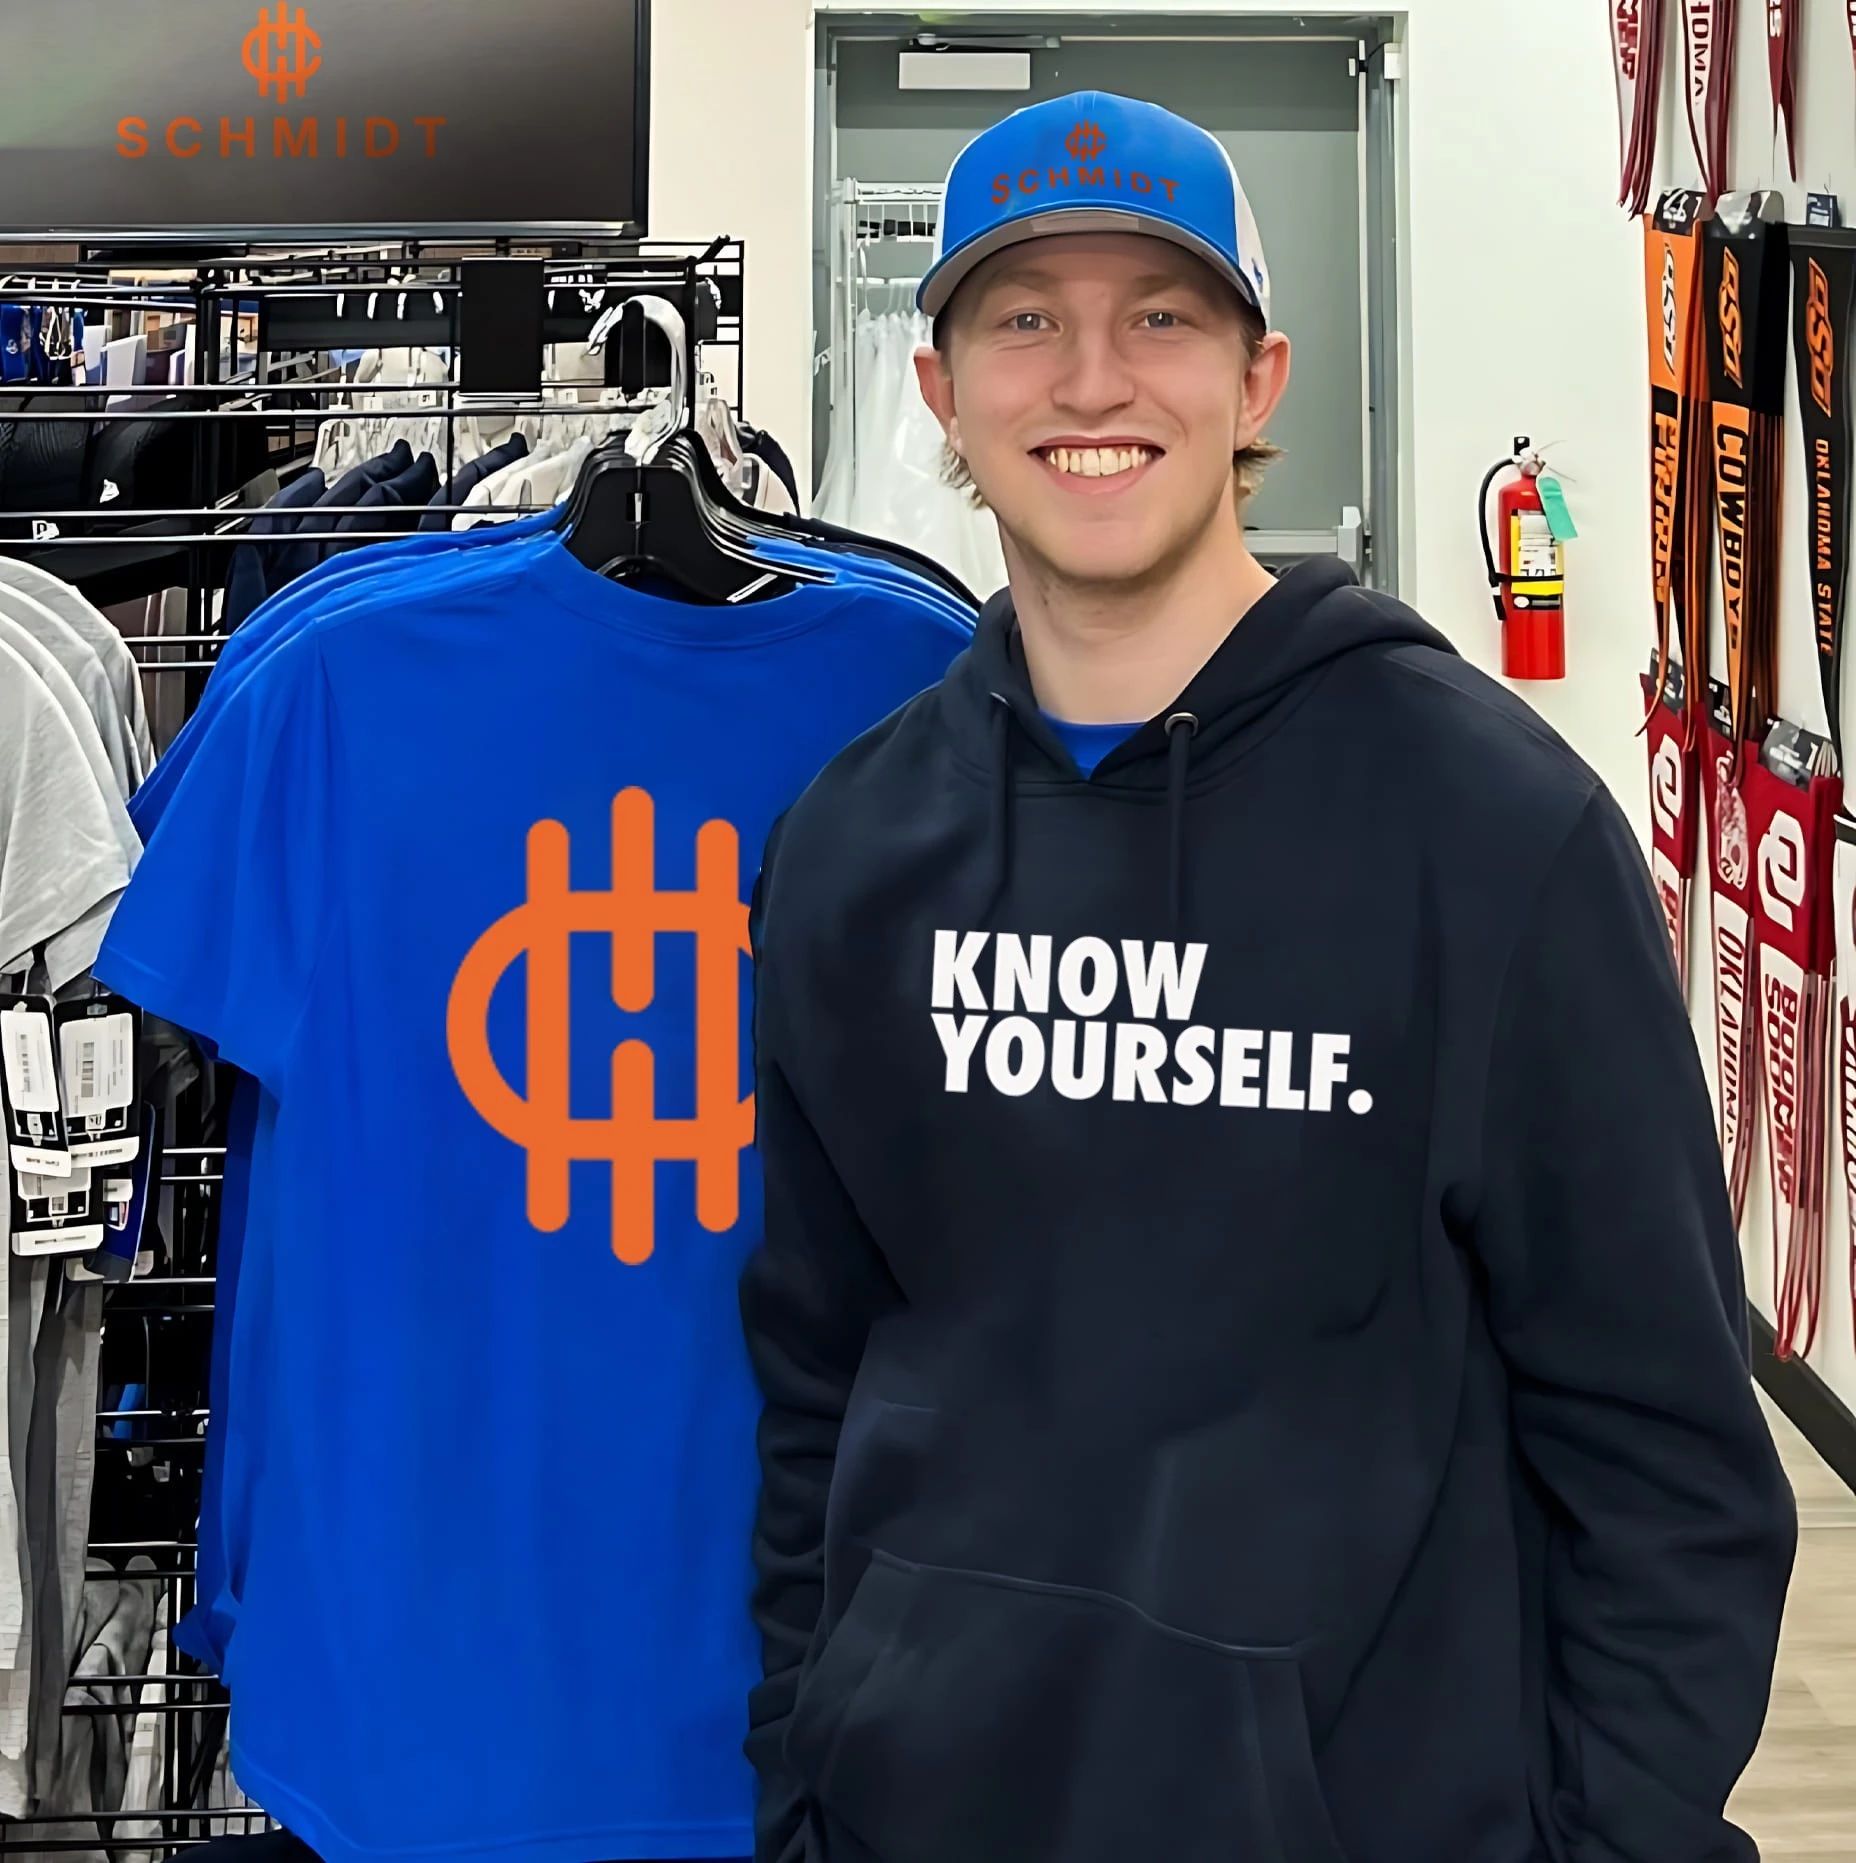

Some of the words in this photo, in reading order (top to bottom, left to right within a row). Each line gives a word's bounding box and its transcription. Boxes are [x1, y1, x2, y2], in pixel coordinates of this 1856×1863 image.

[115, 116, 447, 158] SCHMIDT
[991, 165, 1181, 204] SCHMIDT
[1815, 438, 1832, 570] OKLAHOMA
[931, 929, 1209, 1020] KNOW
[930, 1012, 1373, 1115] YOURSELF.
[1718, 926, 1744, 1144] OKLAHOMA
